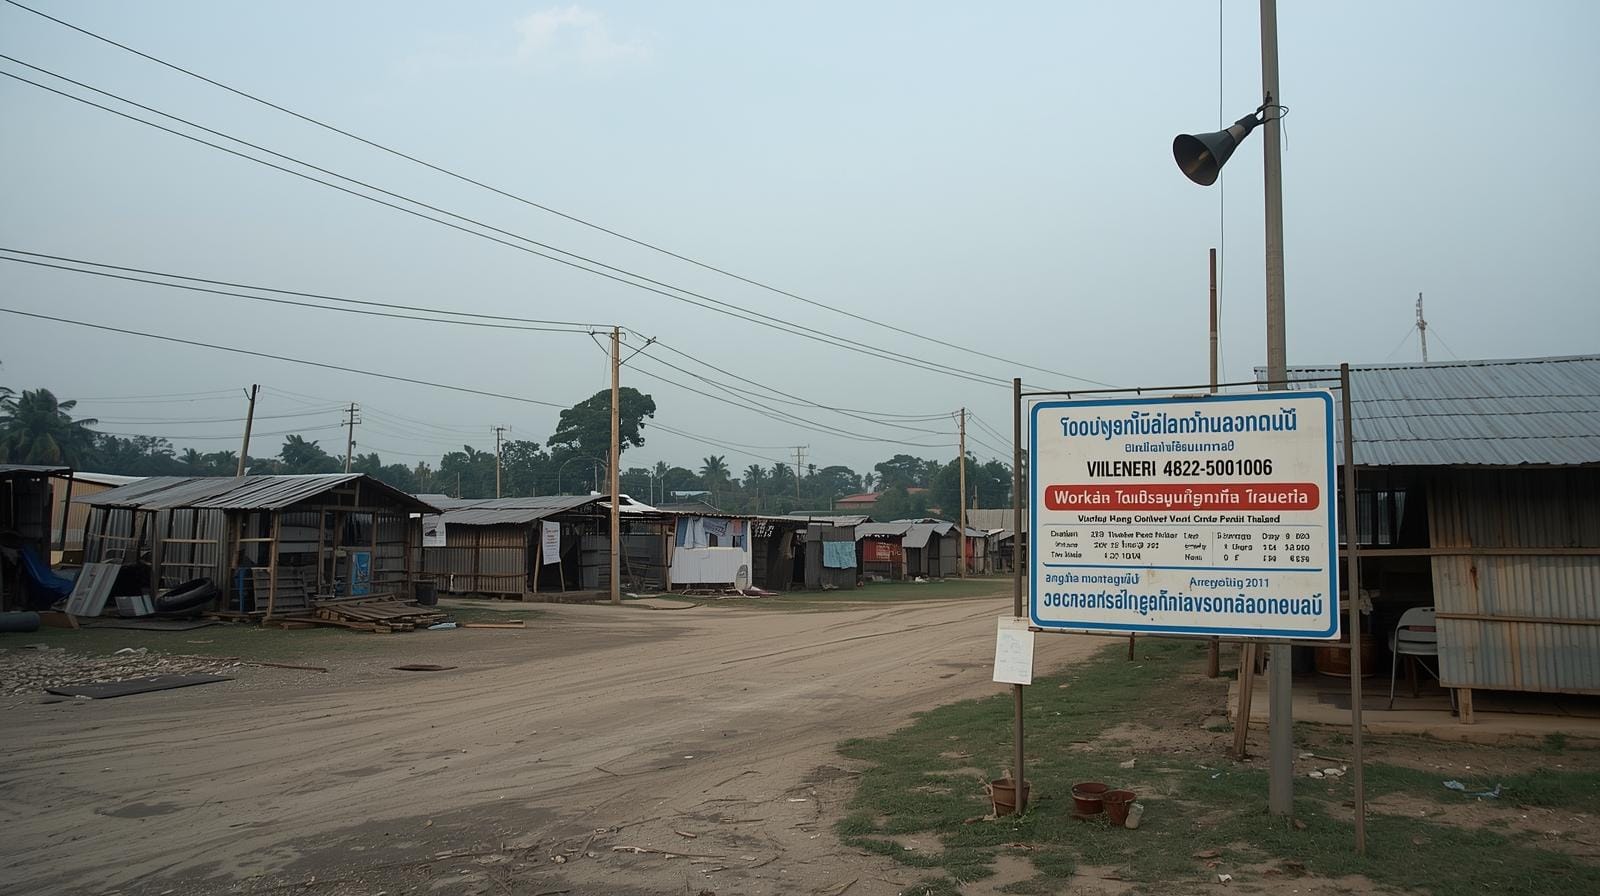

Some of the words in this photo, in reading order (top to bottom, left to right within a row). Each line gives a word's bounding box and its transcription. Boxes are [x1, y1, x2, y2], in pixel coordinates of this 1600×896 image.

[1087, 460, 1156, 477] VIILENERI
[1163, 458, 1273, 477] 4822-5001006
[1245, 578, 1270, 588] 2011
